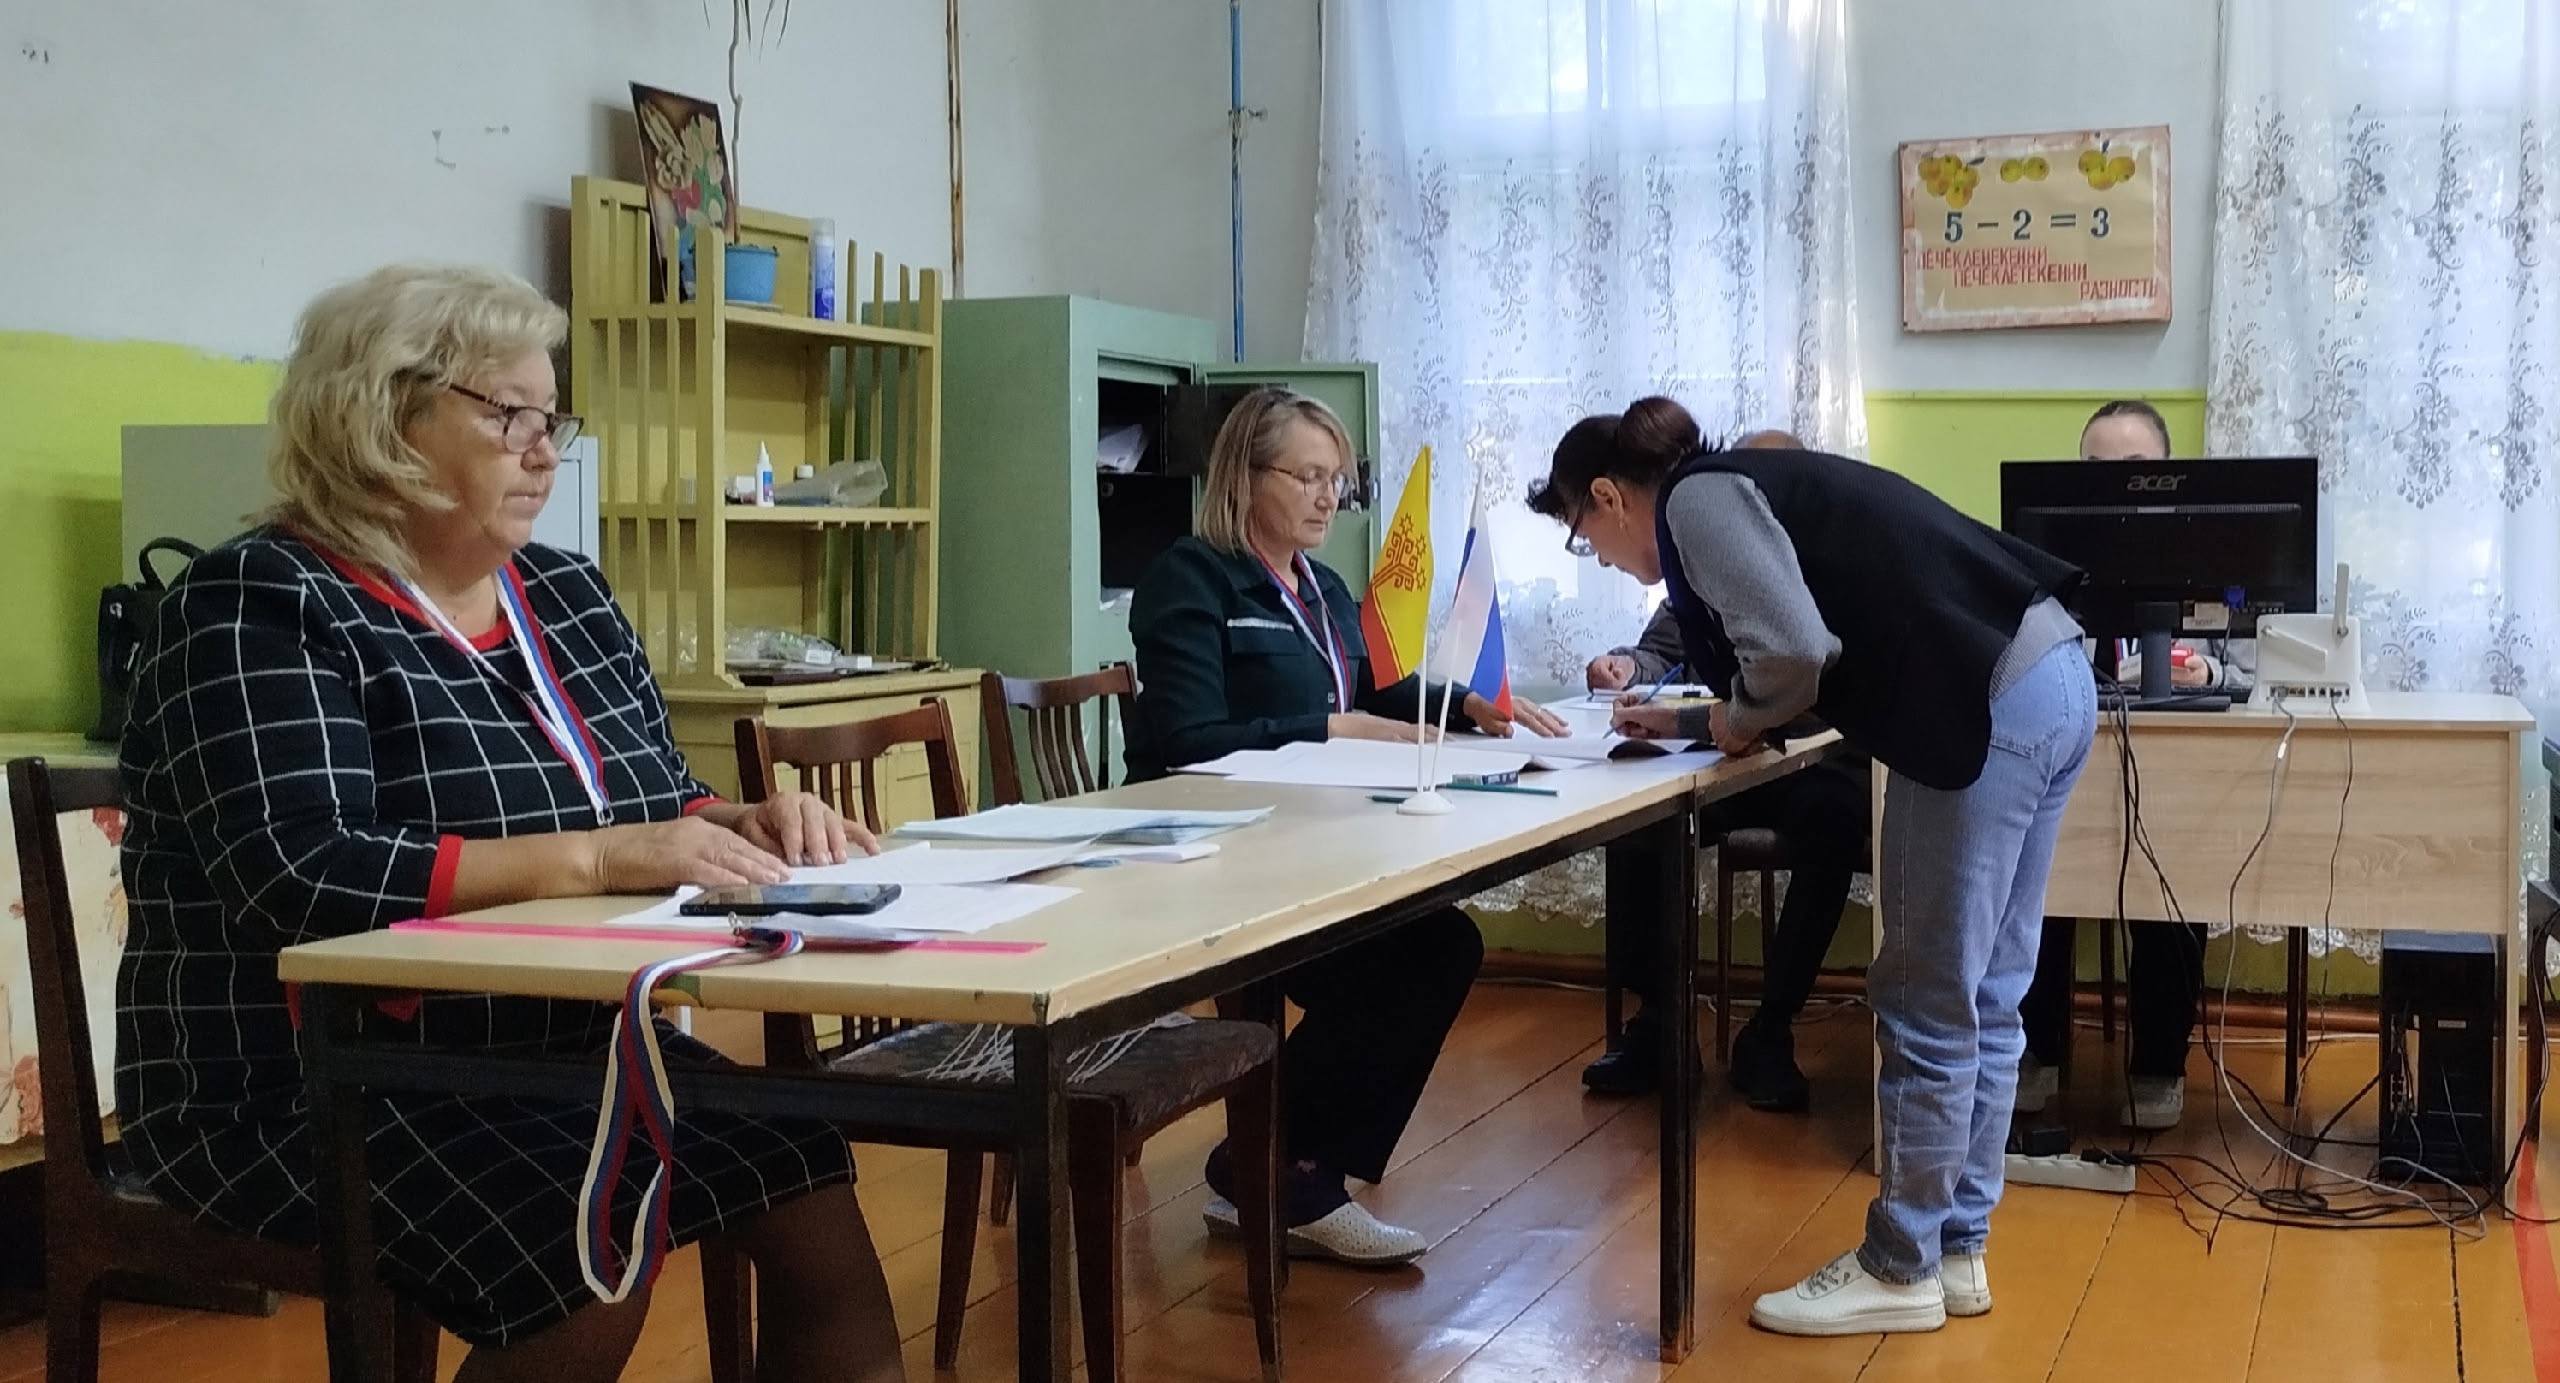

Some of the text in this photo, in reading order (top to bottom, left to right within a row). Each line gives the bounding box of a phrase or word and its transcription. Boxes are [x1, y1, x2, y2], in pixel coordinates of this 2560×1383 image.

[1944, 211, 1964, 243] 5
[2012, 208, 2032, 240] 2
[2050, 214, 2076, 228] =
[2090, 207, 2109, 238] 3
[2080, 277, 2158, 300] РАЗНОСТЬ
[2126, 473, 2188, 491] acer
